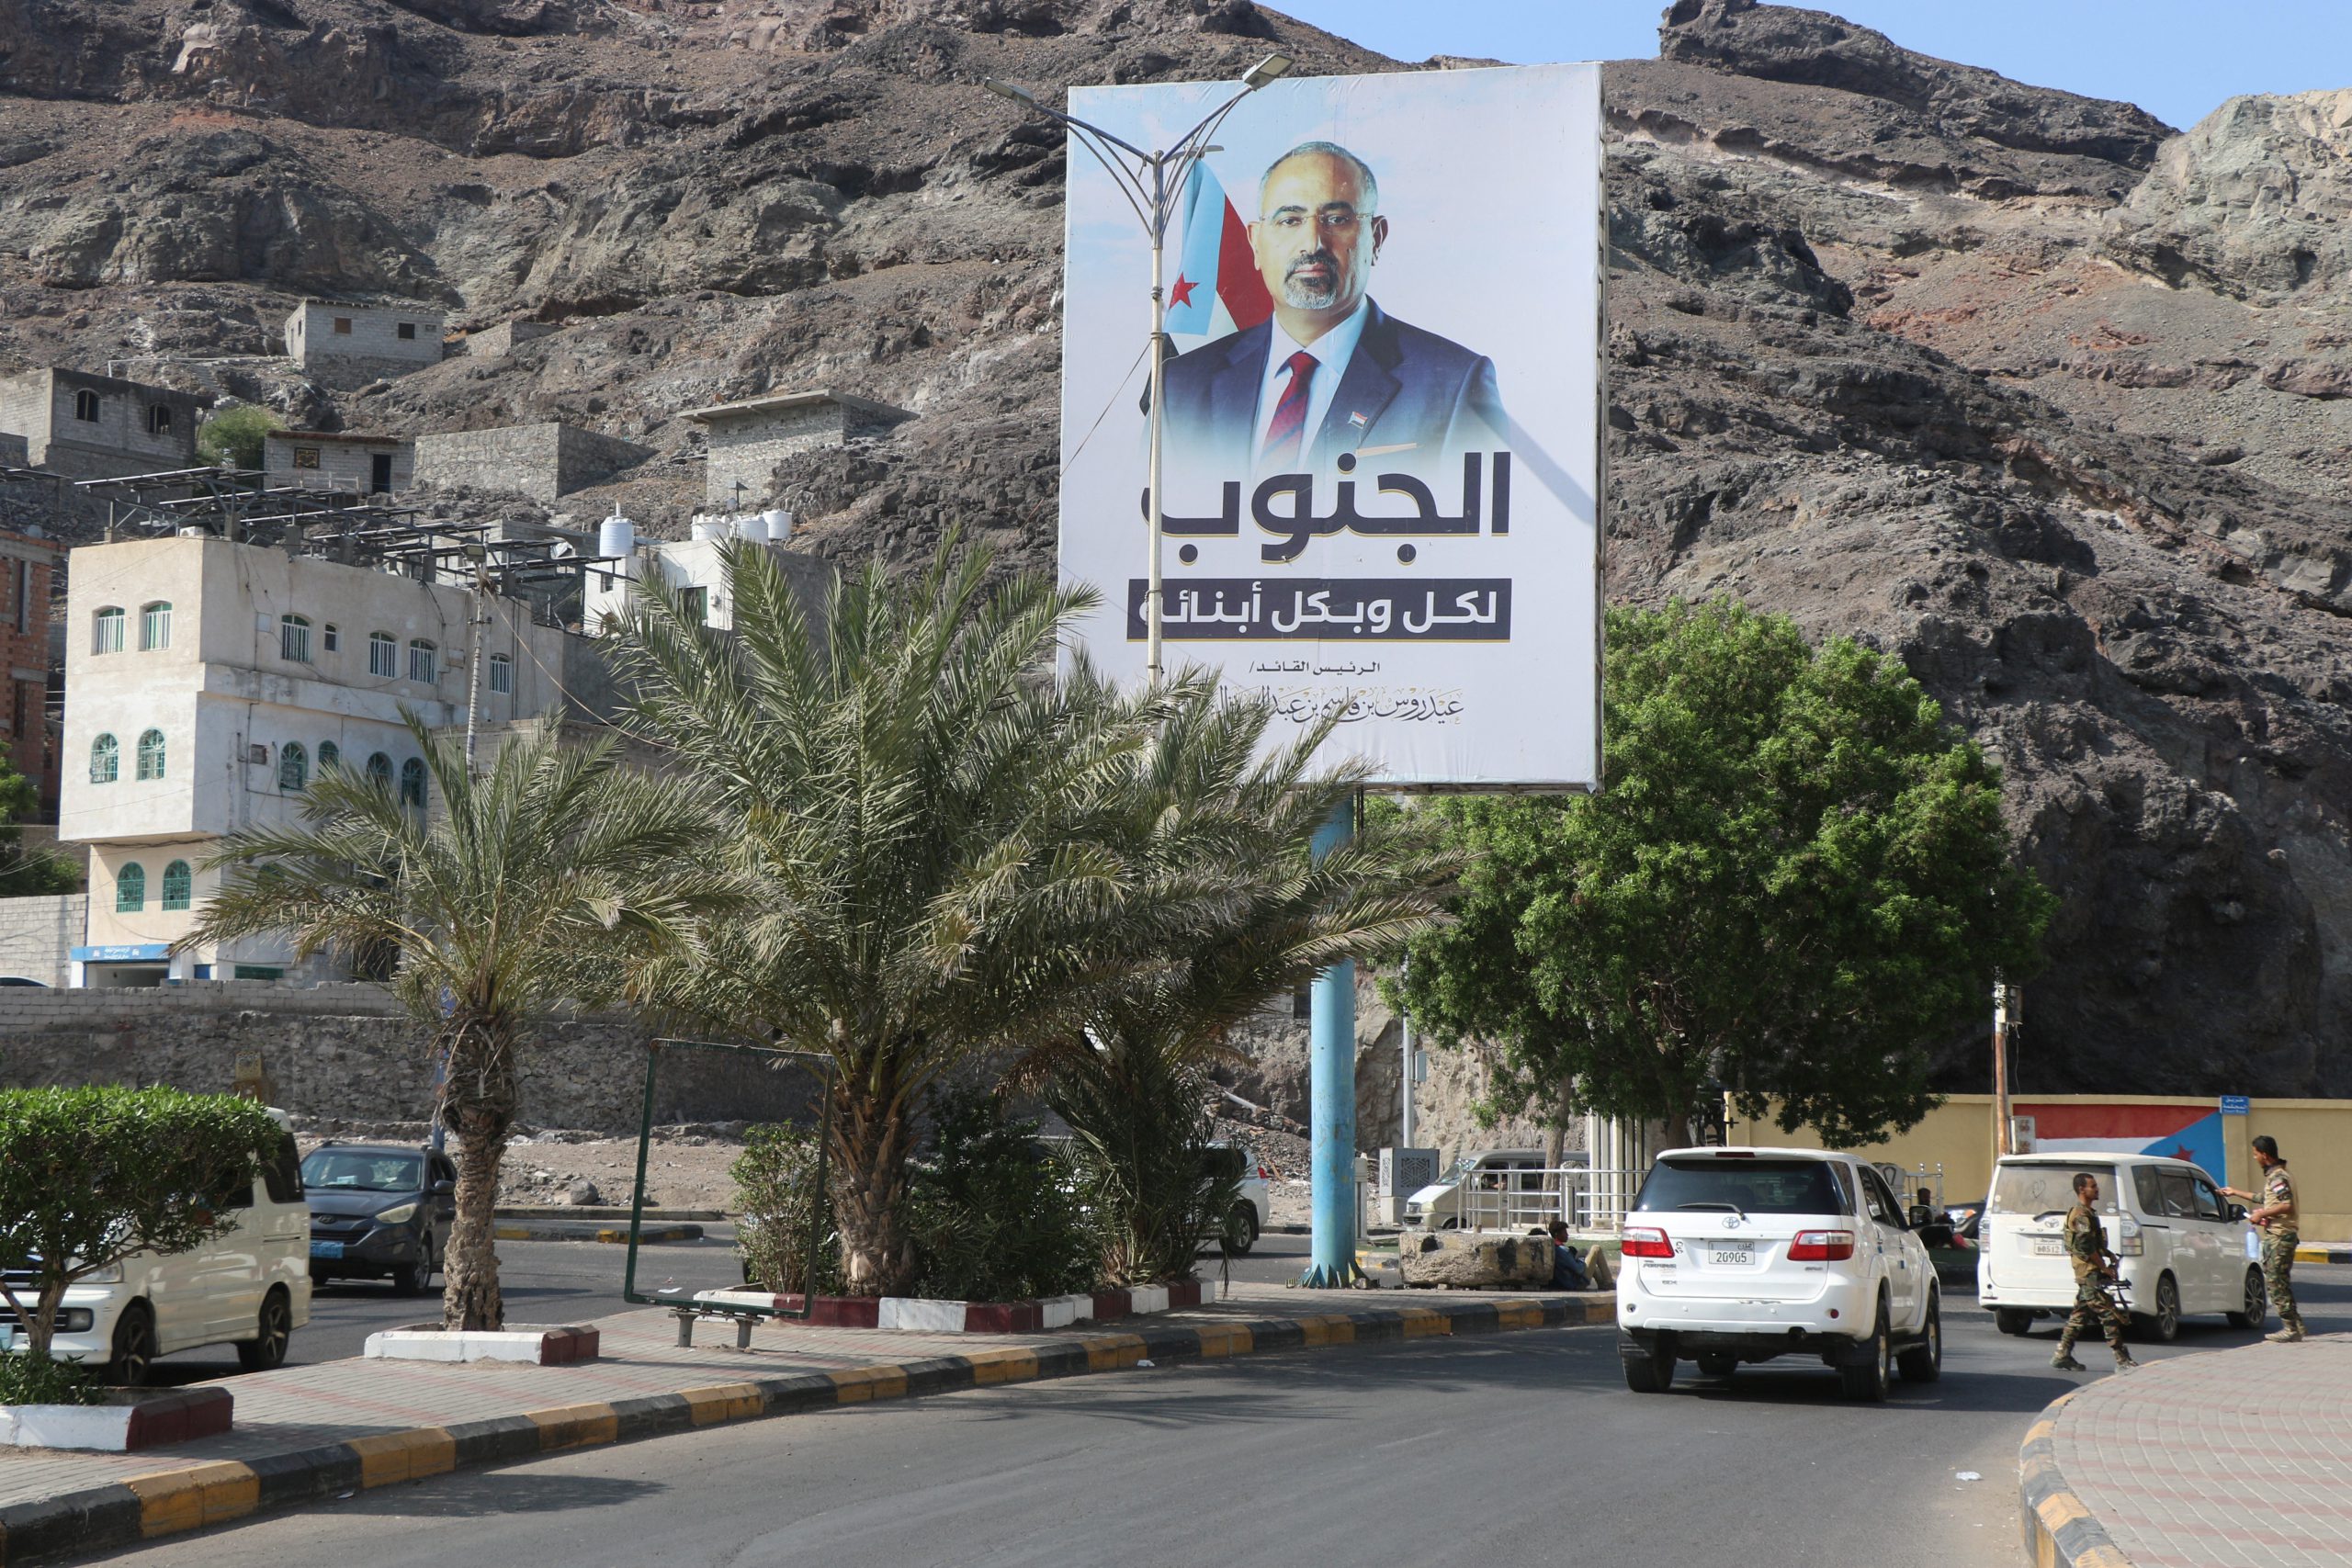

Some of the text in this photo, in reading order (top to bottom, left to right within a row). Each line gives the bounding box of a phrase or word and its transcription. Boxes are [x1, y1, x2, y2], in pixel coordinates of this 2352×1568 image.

[1140, 452, 1510, 565] الجنوب
[1272, 590, 1392, 634] وبكل
[1403, 590, 1497, 633] لكل
[1313, 661, 1380, 676] الرئيس
[1716, 1251, 1747, 1263] 20905
